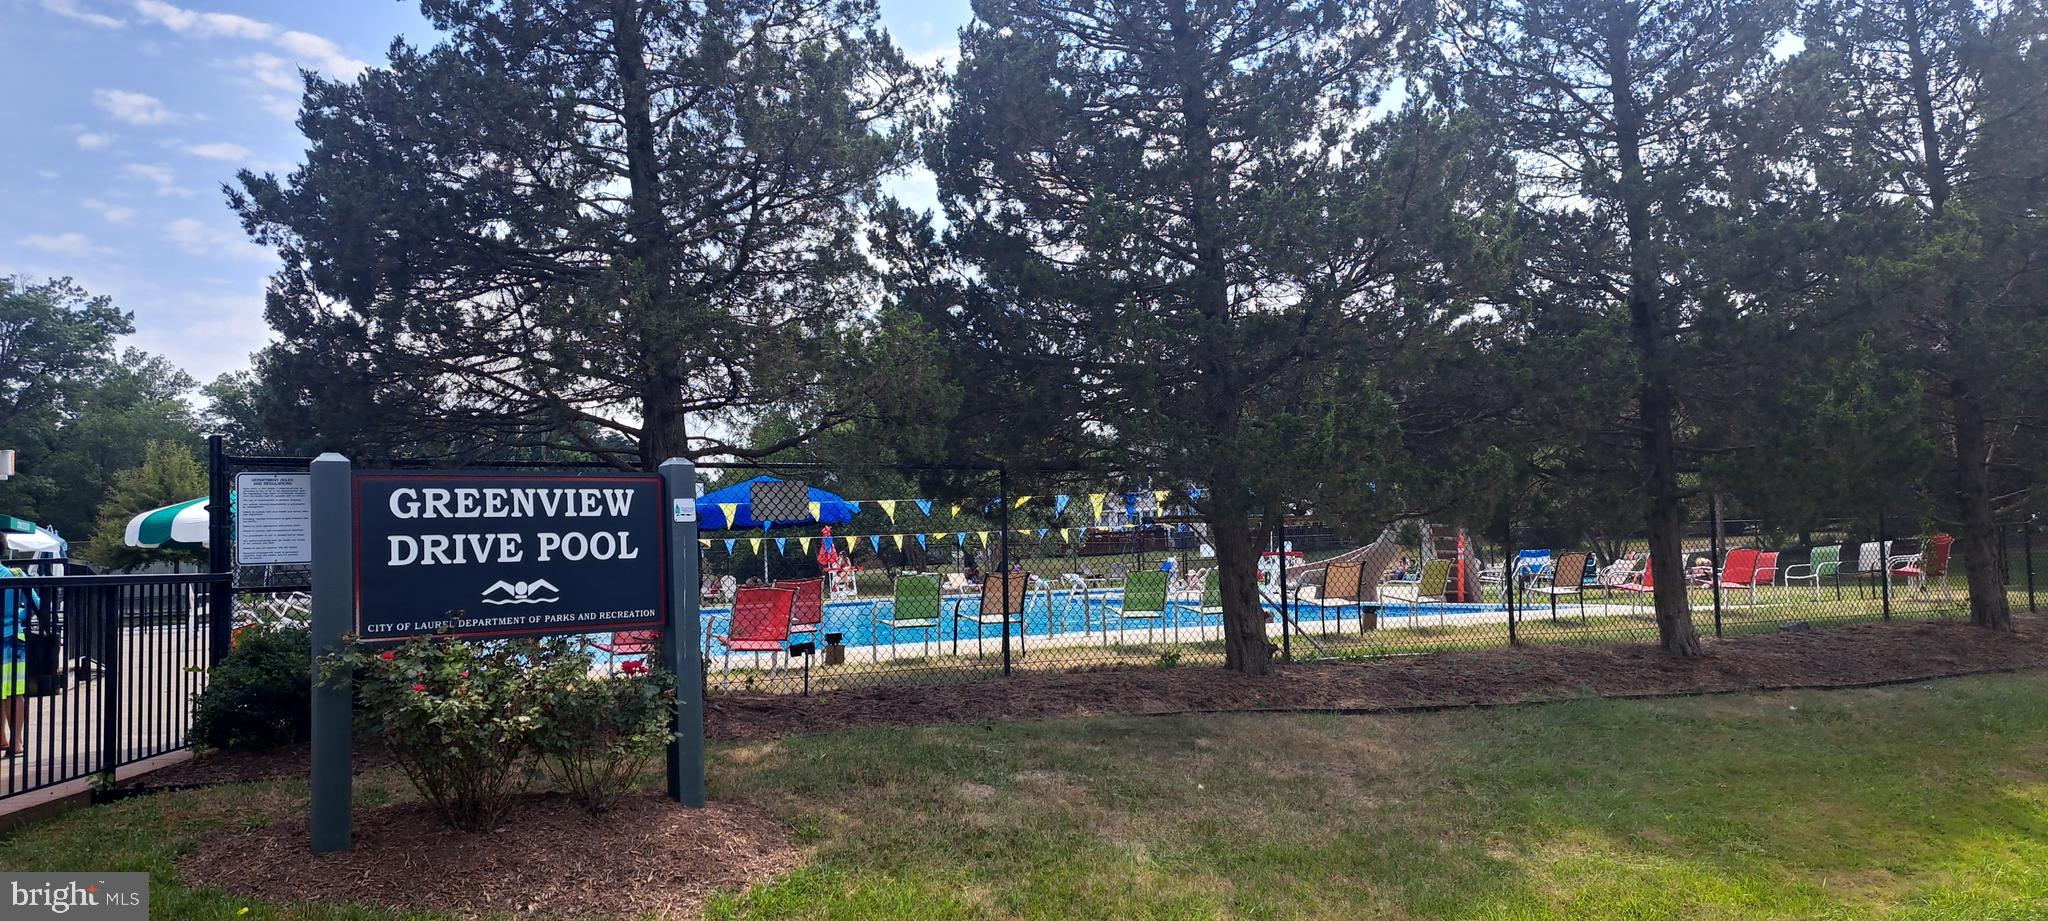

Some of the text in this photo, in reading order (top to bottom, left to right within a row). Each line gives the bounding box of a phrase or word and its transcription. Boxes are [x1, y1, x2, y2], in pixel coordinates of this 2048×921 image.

[389, 488, 635, 519] GREENVIEW
[387, 531, 639, 566] DRIVE POOL
[367, 624, 393, 632] CITY
[396, 622, 411, 631] OF
[458, 616, 525, 628] DEPARTMENT
[528, 616, 541, 624] OF
[544, 613, 576, 623] PARKS
[577, 612, 597, 621] AND
[599, 609, 656, 620] RECREATION
